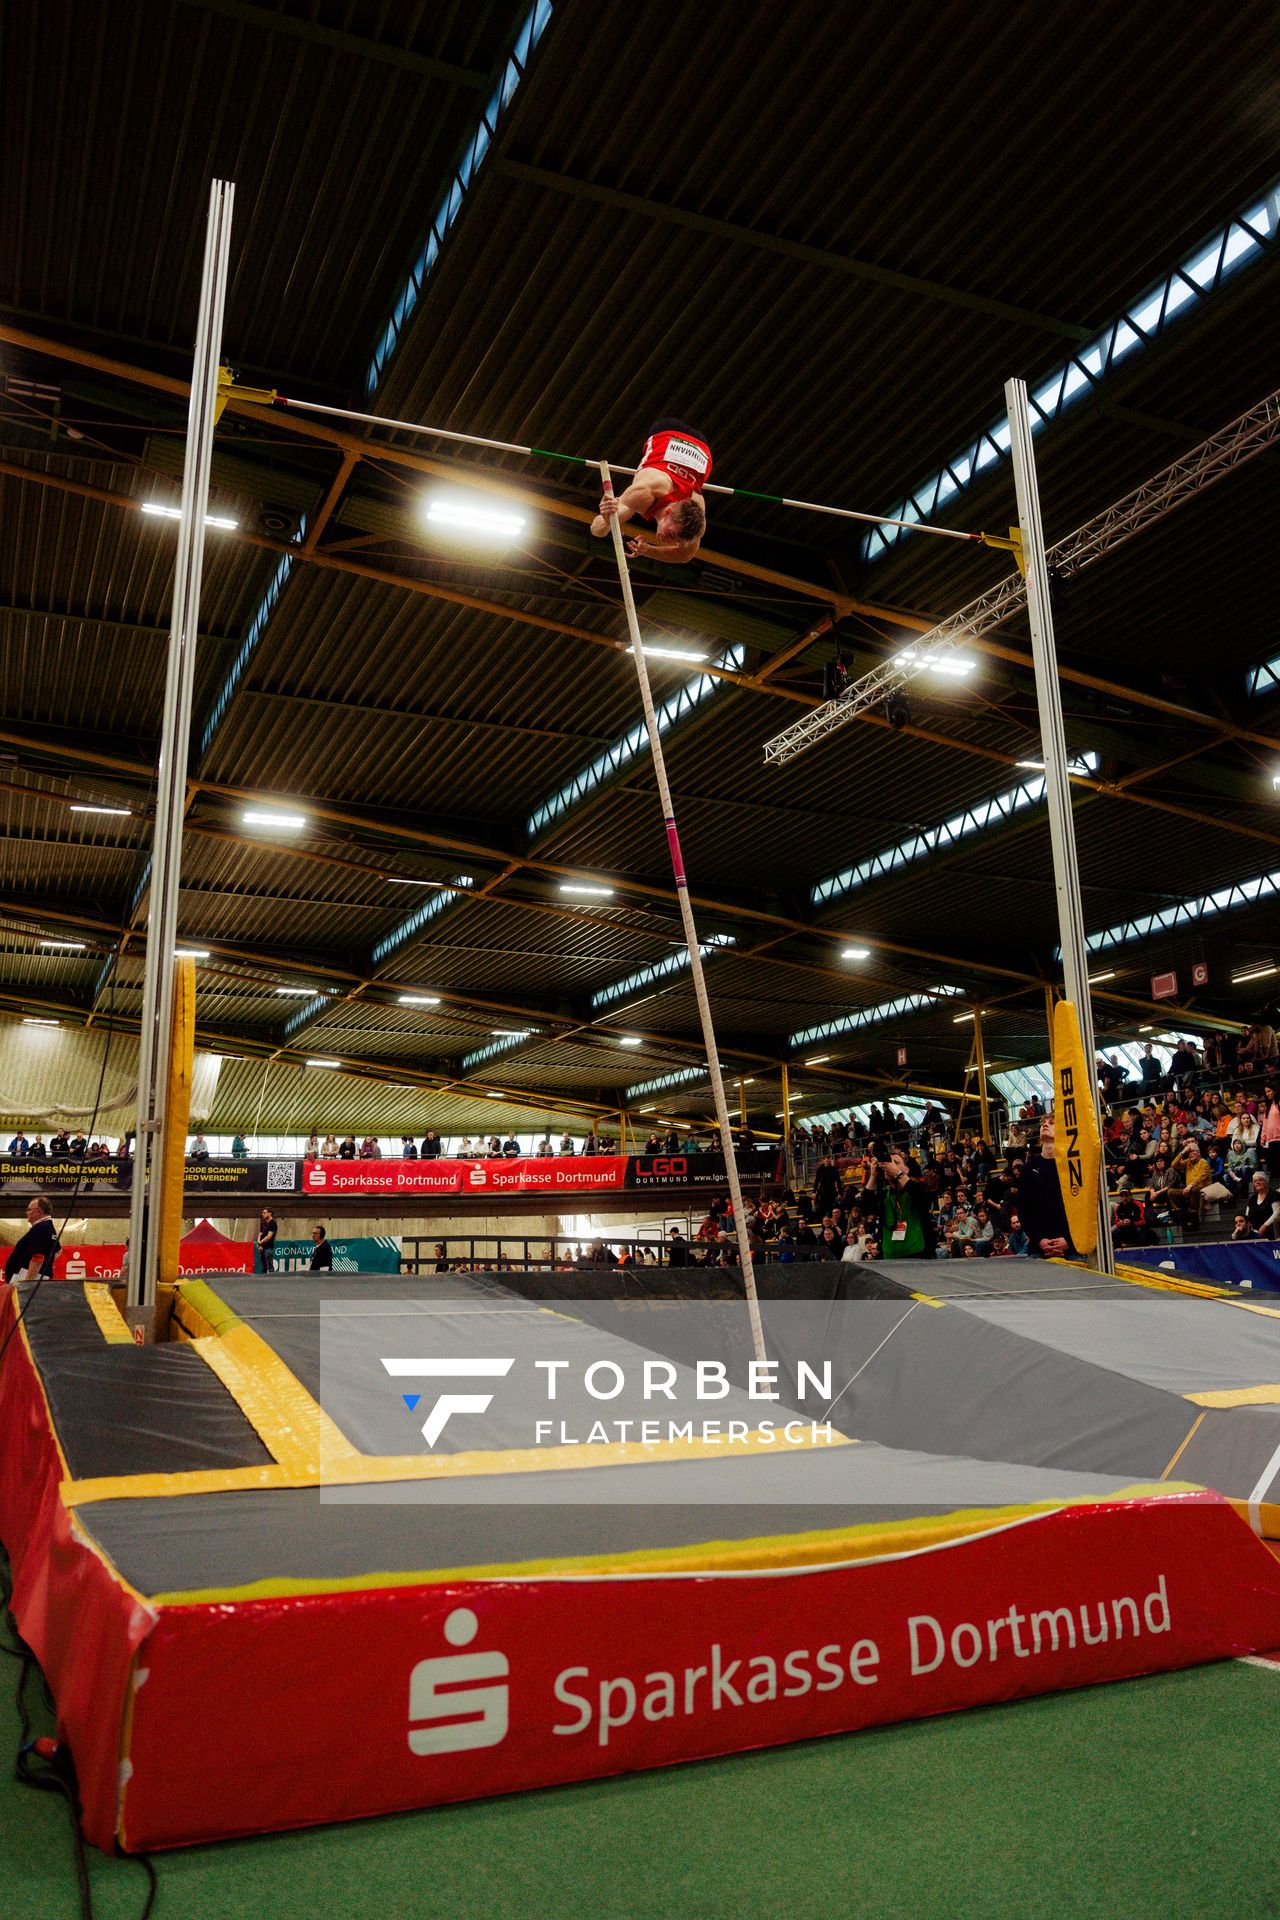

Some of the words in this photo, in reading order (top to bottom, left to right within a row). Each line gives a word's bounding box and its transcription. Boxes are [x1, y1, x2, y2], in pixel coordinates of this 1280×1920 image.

[666, 462, 697, 485] LGO
[1195, 966, 1206, 982] G
[1, 1163, 119, 1174] BusinessNetzwerk
[207, 1166, 248, 1174] SCANNEN
[635, 1157, 688, 1176] LGO
[0, 1175, 44, 1183] ntrittskarte
[200, 1174, 239, 1182] WERDEN!
[332, 1174, 393, 1188] Sparkasse
[397, 1174, 457, 1186] Dortmund
[492, 1172, 552, 1187] Sparkasse
[556, 1171, 616, 1183] Dortmund
[636, 1176, 688, 1184] DORTMUND
[552, 1637, 880, 1746] Sparkasse
[907, 1574, 1173, 1677] Dortmund
